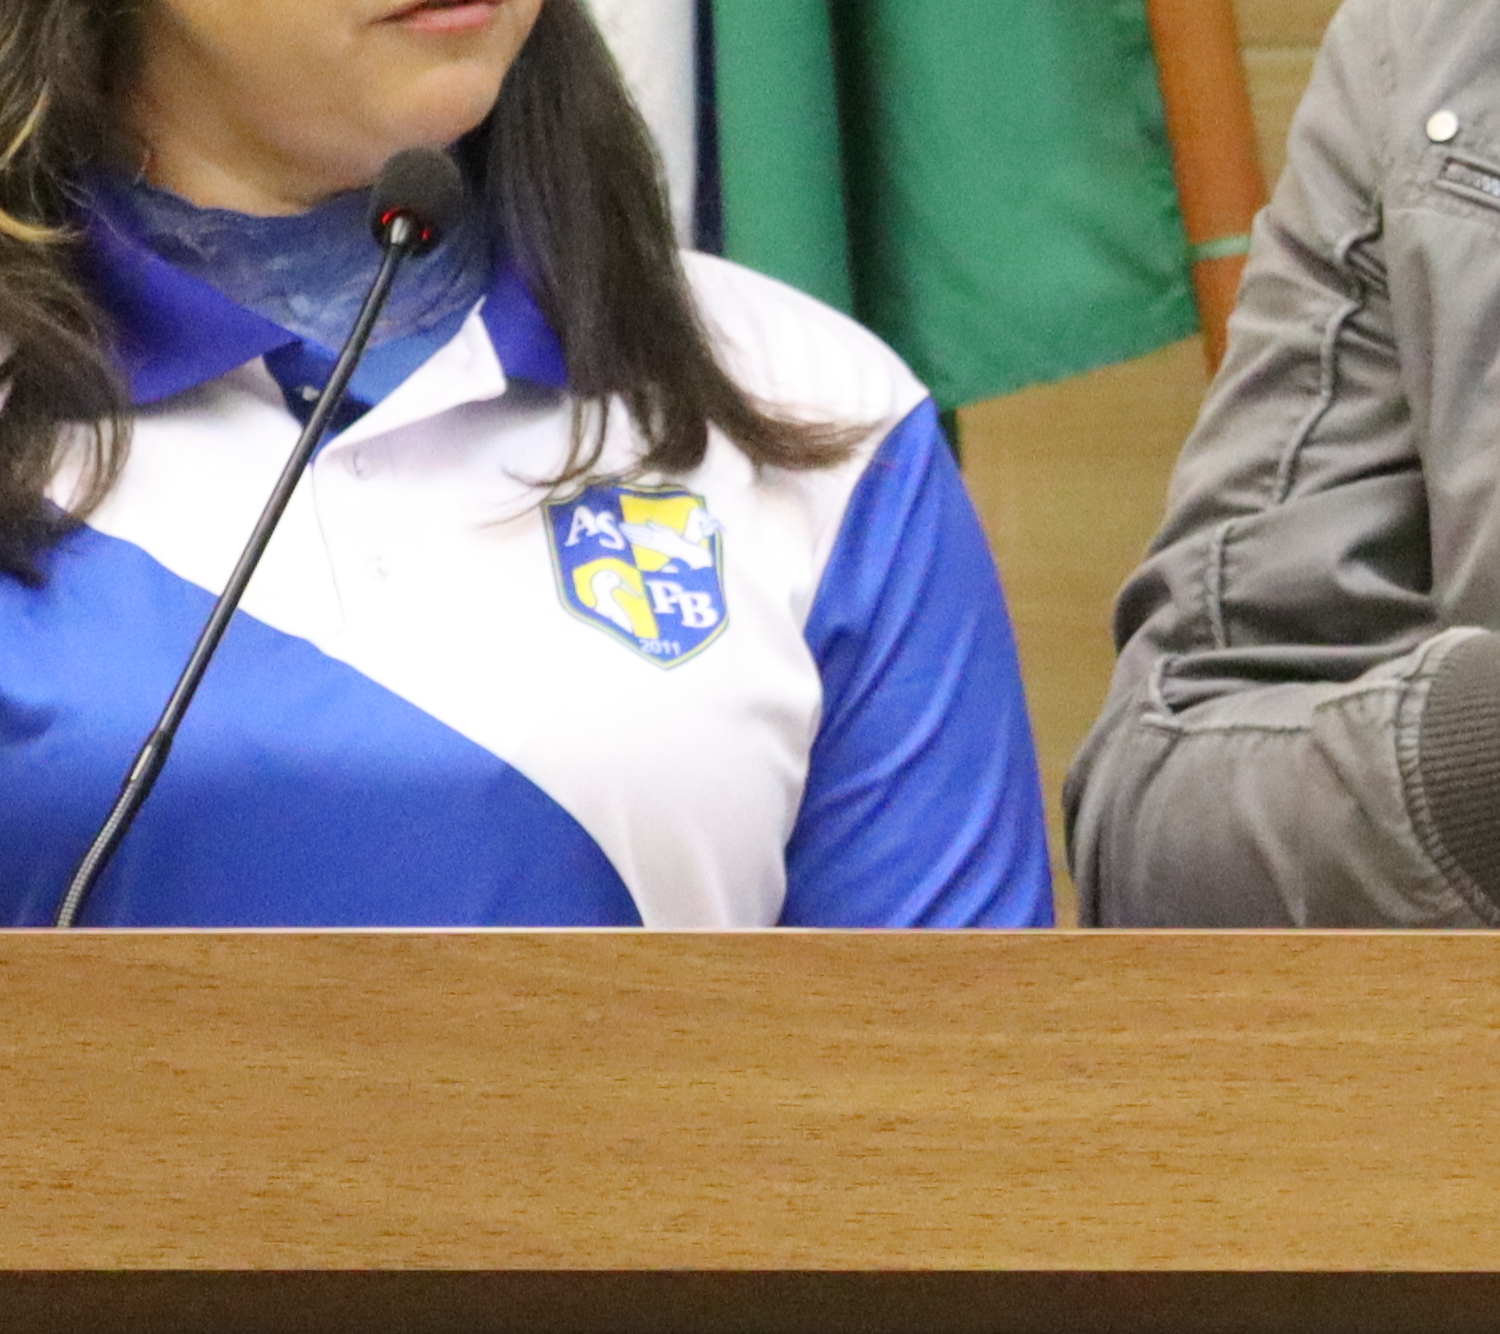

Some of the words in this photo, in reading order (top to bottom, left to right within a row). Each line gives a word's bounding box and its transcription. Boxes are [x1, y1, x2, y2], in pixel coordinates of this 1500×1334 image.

[564, 505, 627, 551] AS
[645, 579, 720, 629] PB
[638, 638, 683, 656] 2011
